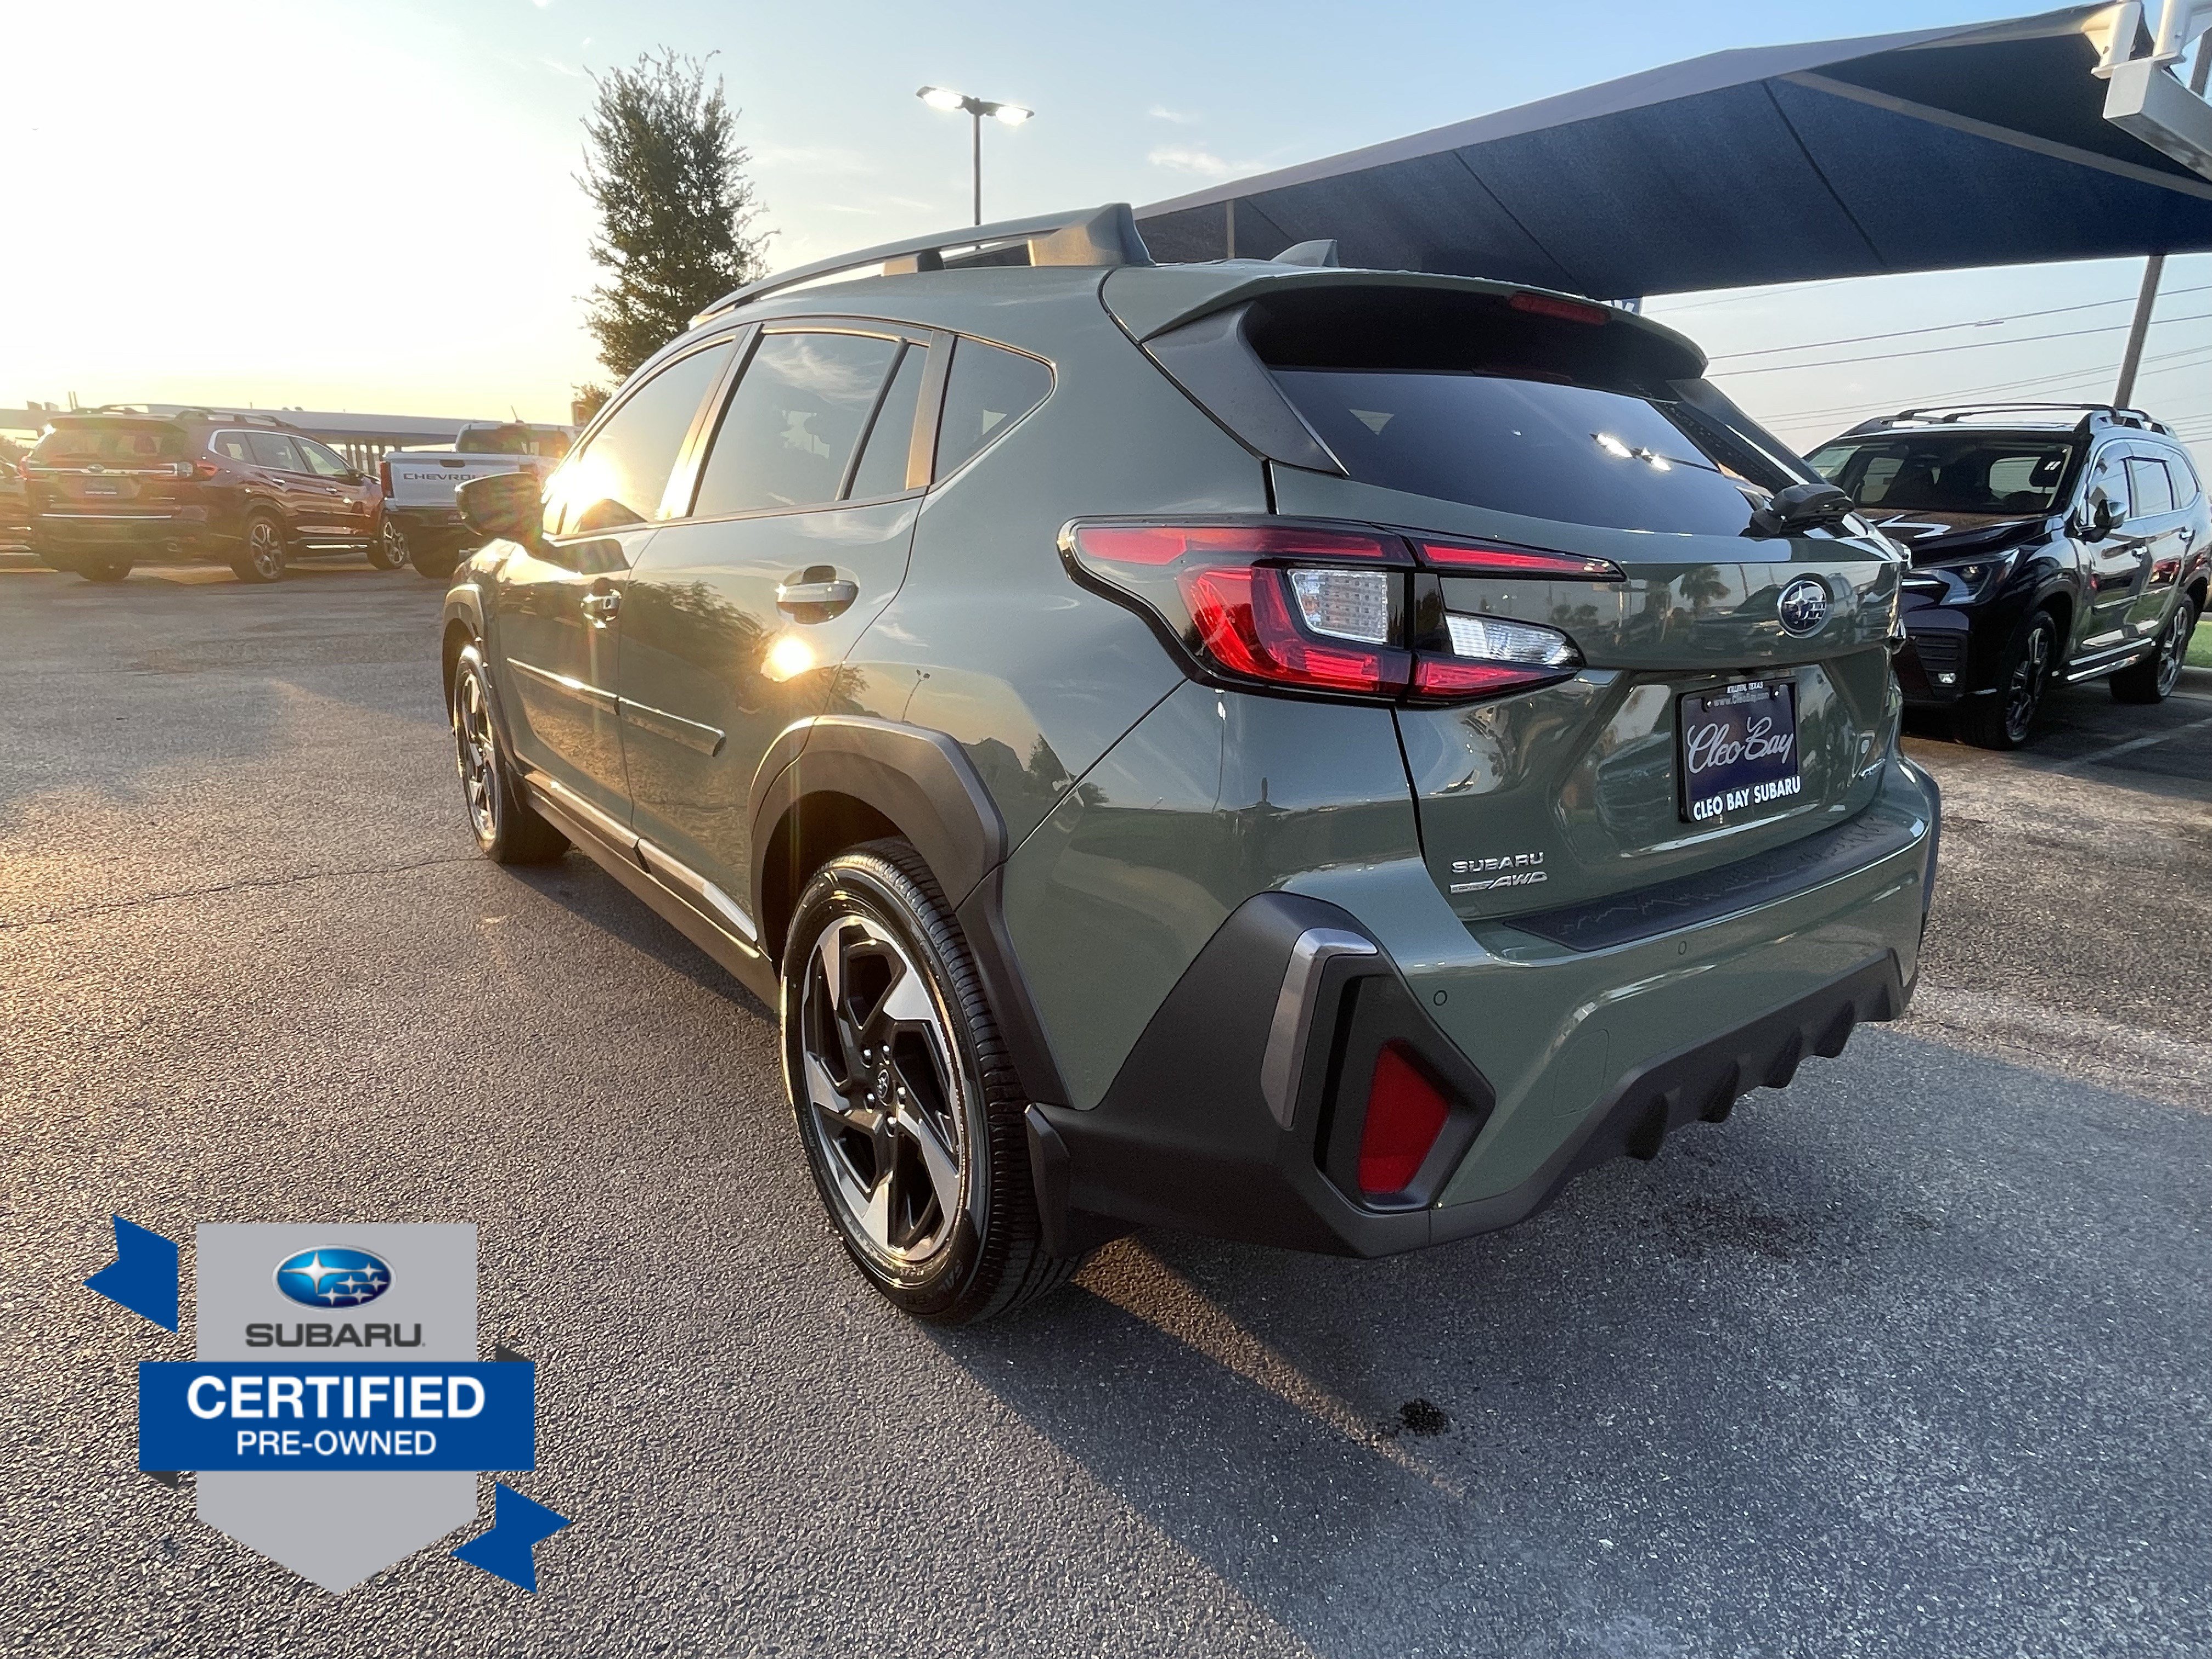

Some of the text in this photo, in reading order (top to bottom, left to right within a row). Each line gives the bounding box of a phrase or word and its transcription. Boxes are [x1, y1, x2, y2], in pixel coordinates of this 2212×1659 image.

[1687, 716, 1794, 774] Cleo Bay
[1693, 776, 1801, 821] CLEO BAY SUBARU
[1452, 852, 1544, 873] SUBARU
[1487, 871, 1548, 890] AWD
